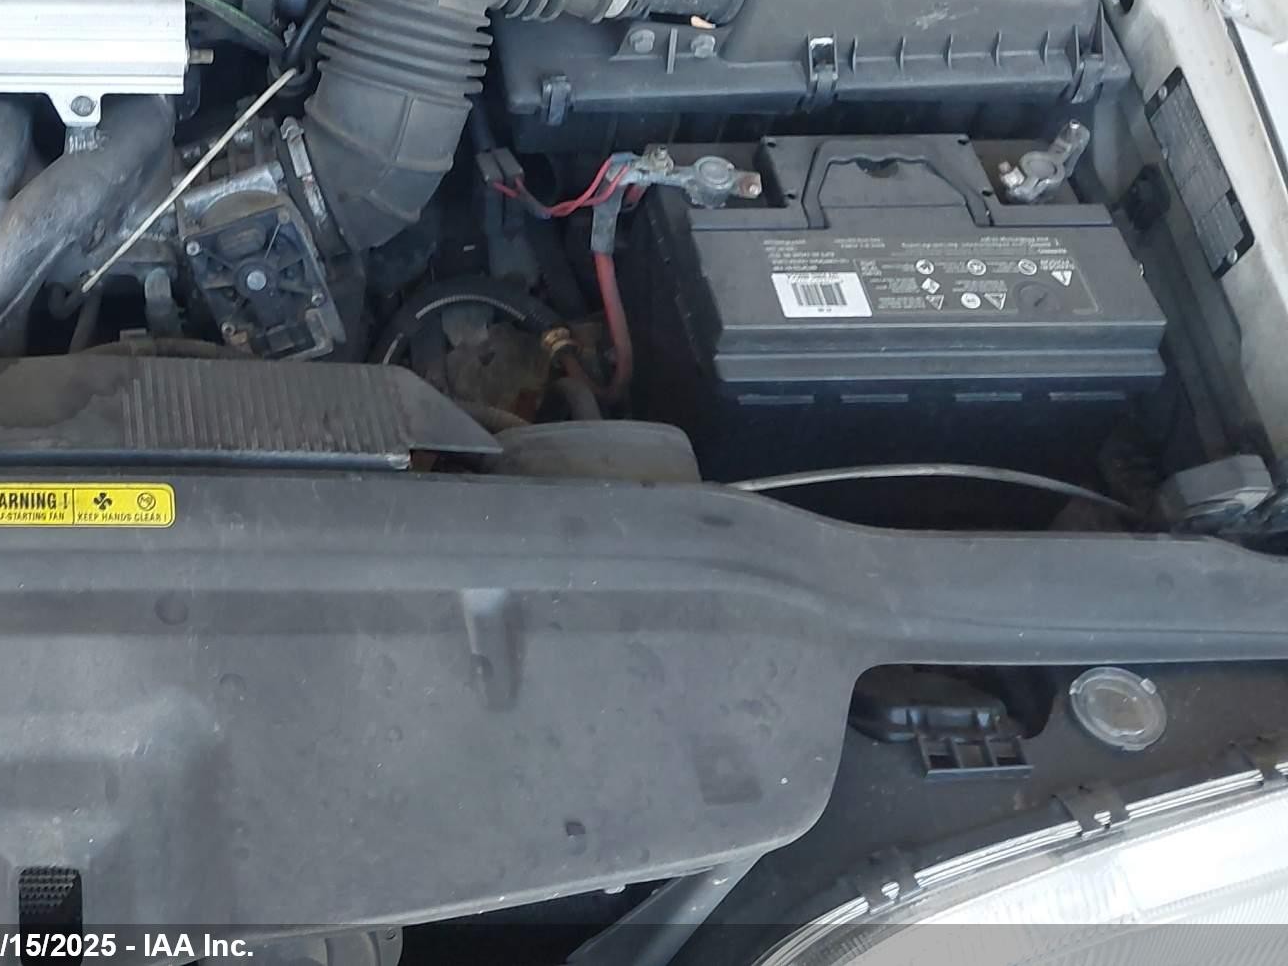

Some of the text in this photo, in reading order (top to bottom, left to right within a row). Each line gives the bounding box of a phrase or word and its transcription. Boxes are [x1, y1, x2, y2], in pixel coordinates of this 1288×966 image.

[62, 491, 68, 510] !
[49, 512, 65, 521] FAN
[77, 512, 98, 522] KEEP
[101, 512, 132, 522] HANDS
[134, 512, 161, 522] CLEAR
